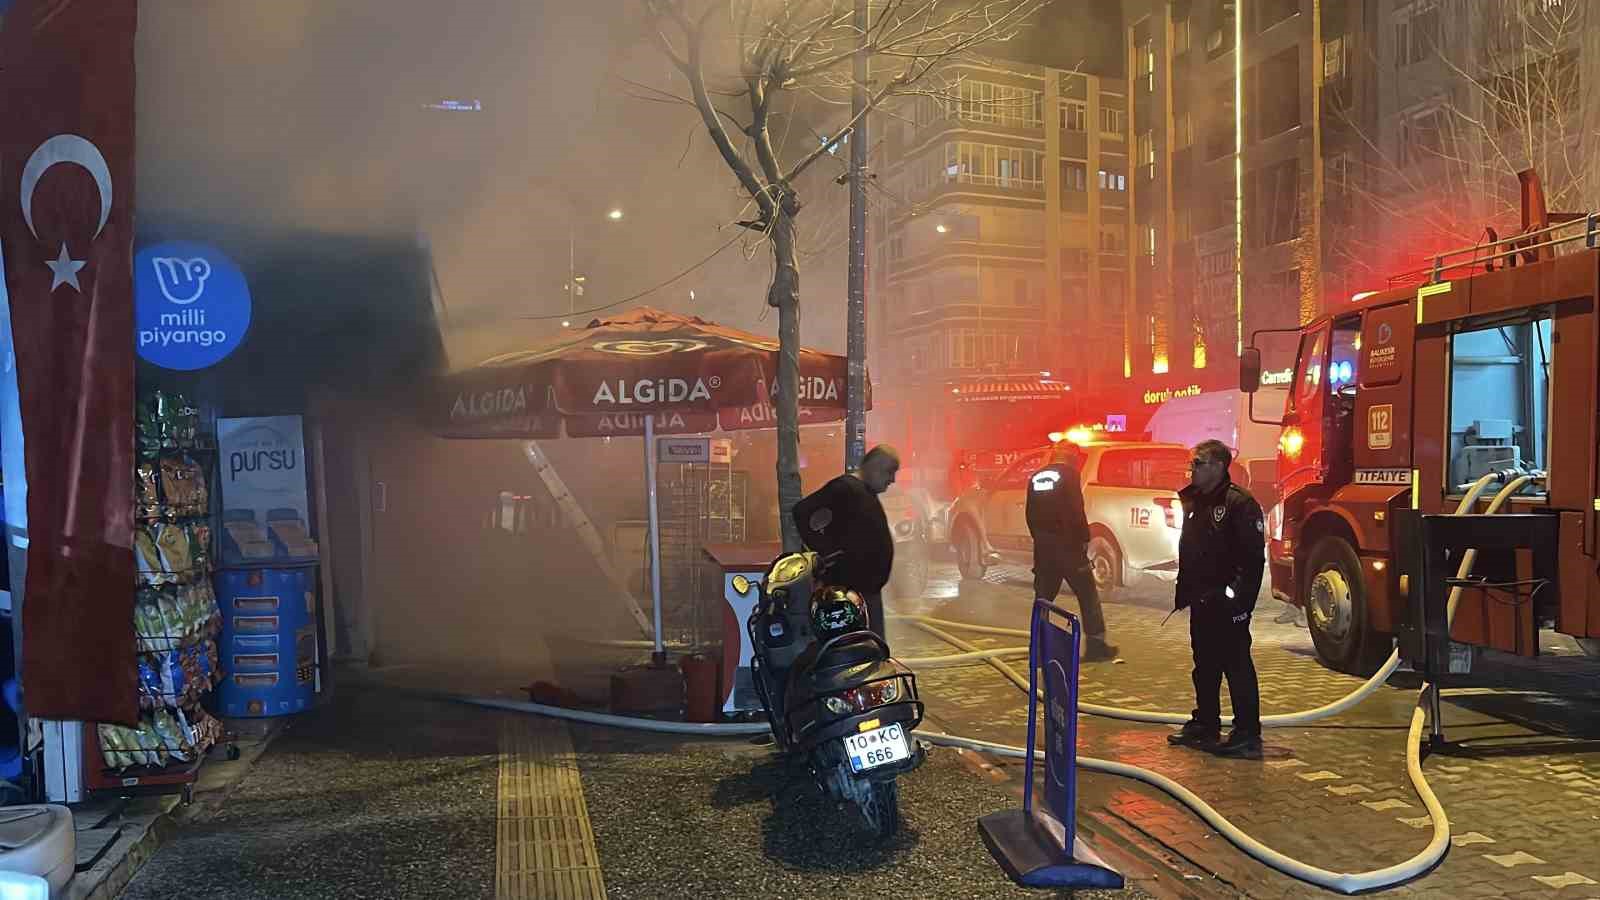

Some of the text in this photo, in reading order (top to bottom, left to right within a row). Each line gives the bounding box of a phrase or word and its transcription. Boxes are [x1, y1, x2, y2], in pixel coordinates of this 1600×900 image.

[160, 308, 205, 326] milli
[140, 327, 226, 347] piyango
[1371, 411, 1388, 431] 112
[230, 449, 296, 482] pursu
[1130, 507, 1150, 525] 112
[849, 727, 899, 751] 10 KC
[866, 747, 894, 764] 666
